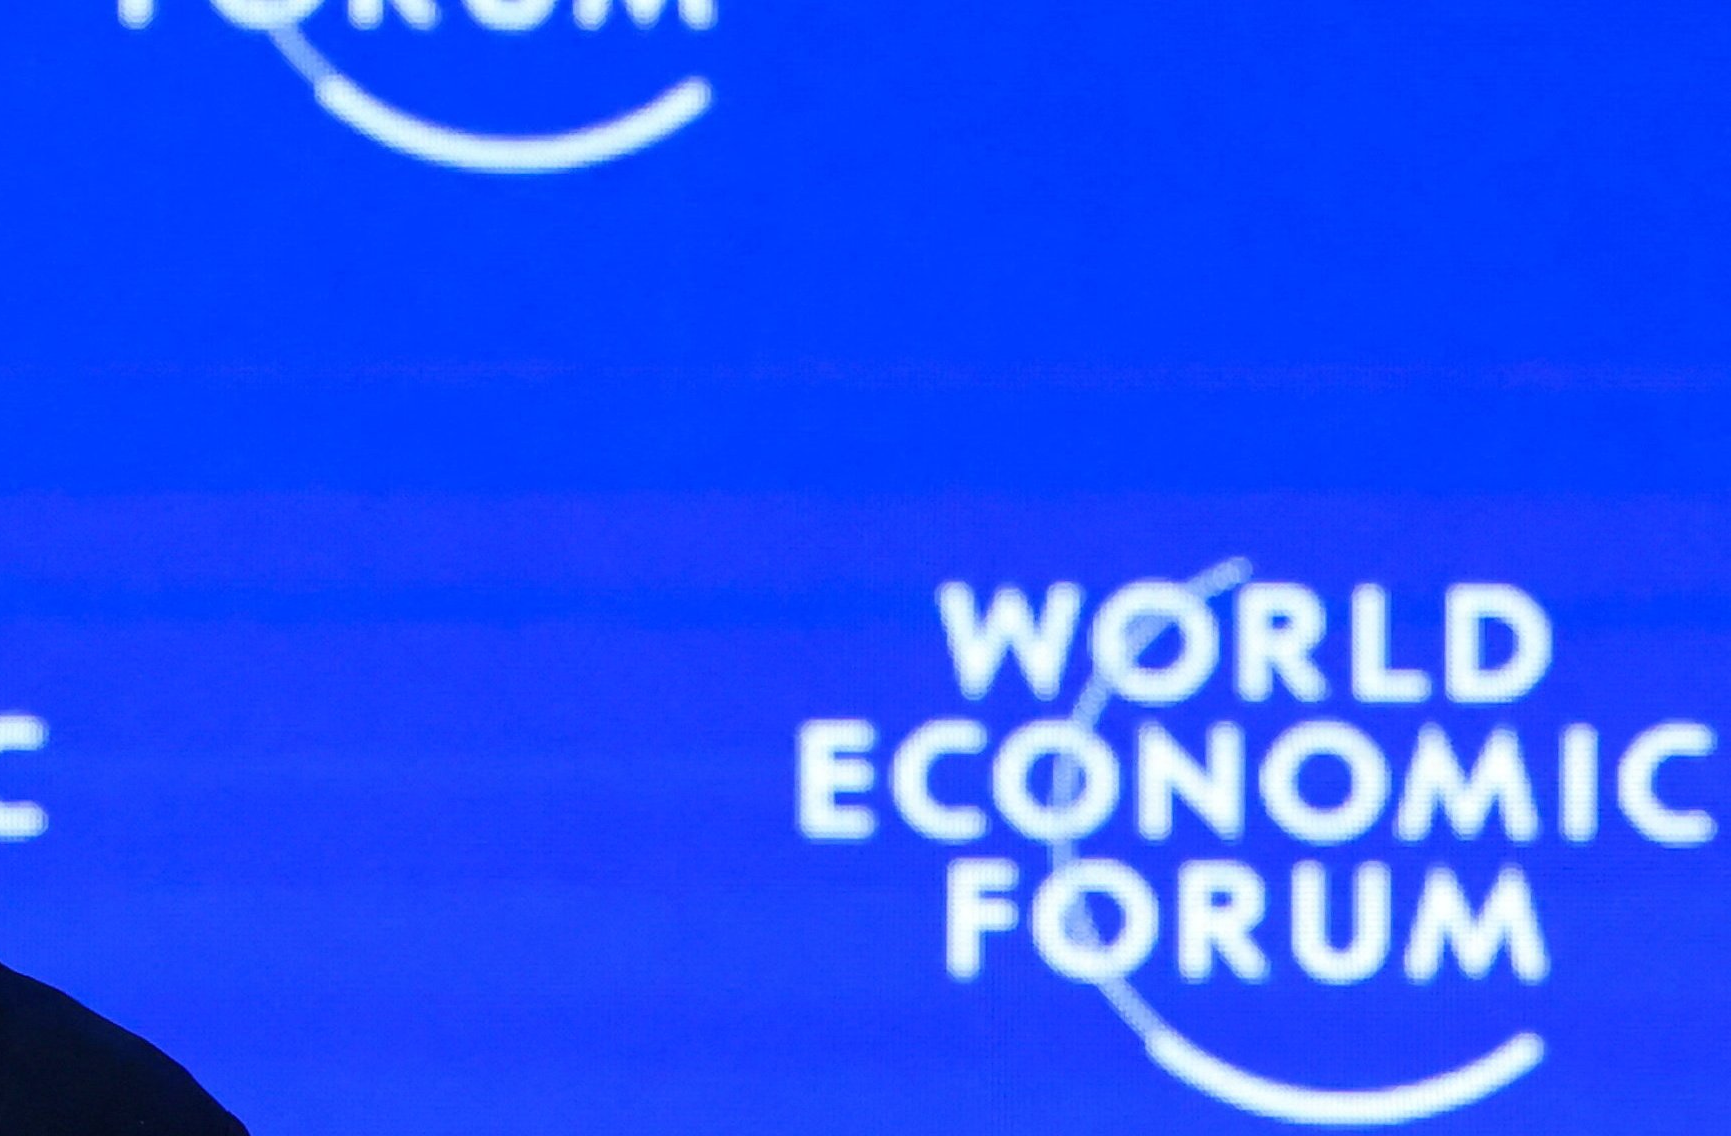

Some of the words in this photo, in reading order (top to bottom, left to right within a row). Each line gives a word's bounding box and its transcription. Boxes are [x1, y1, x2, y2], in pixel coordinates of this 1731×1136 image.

[937, 580, 1553, 706] WORLD
[795, 716, 1718, 846] ECONOMIC
[944, 856, 1551, 985] FORUM
